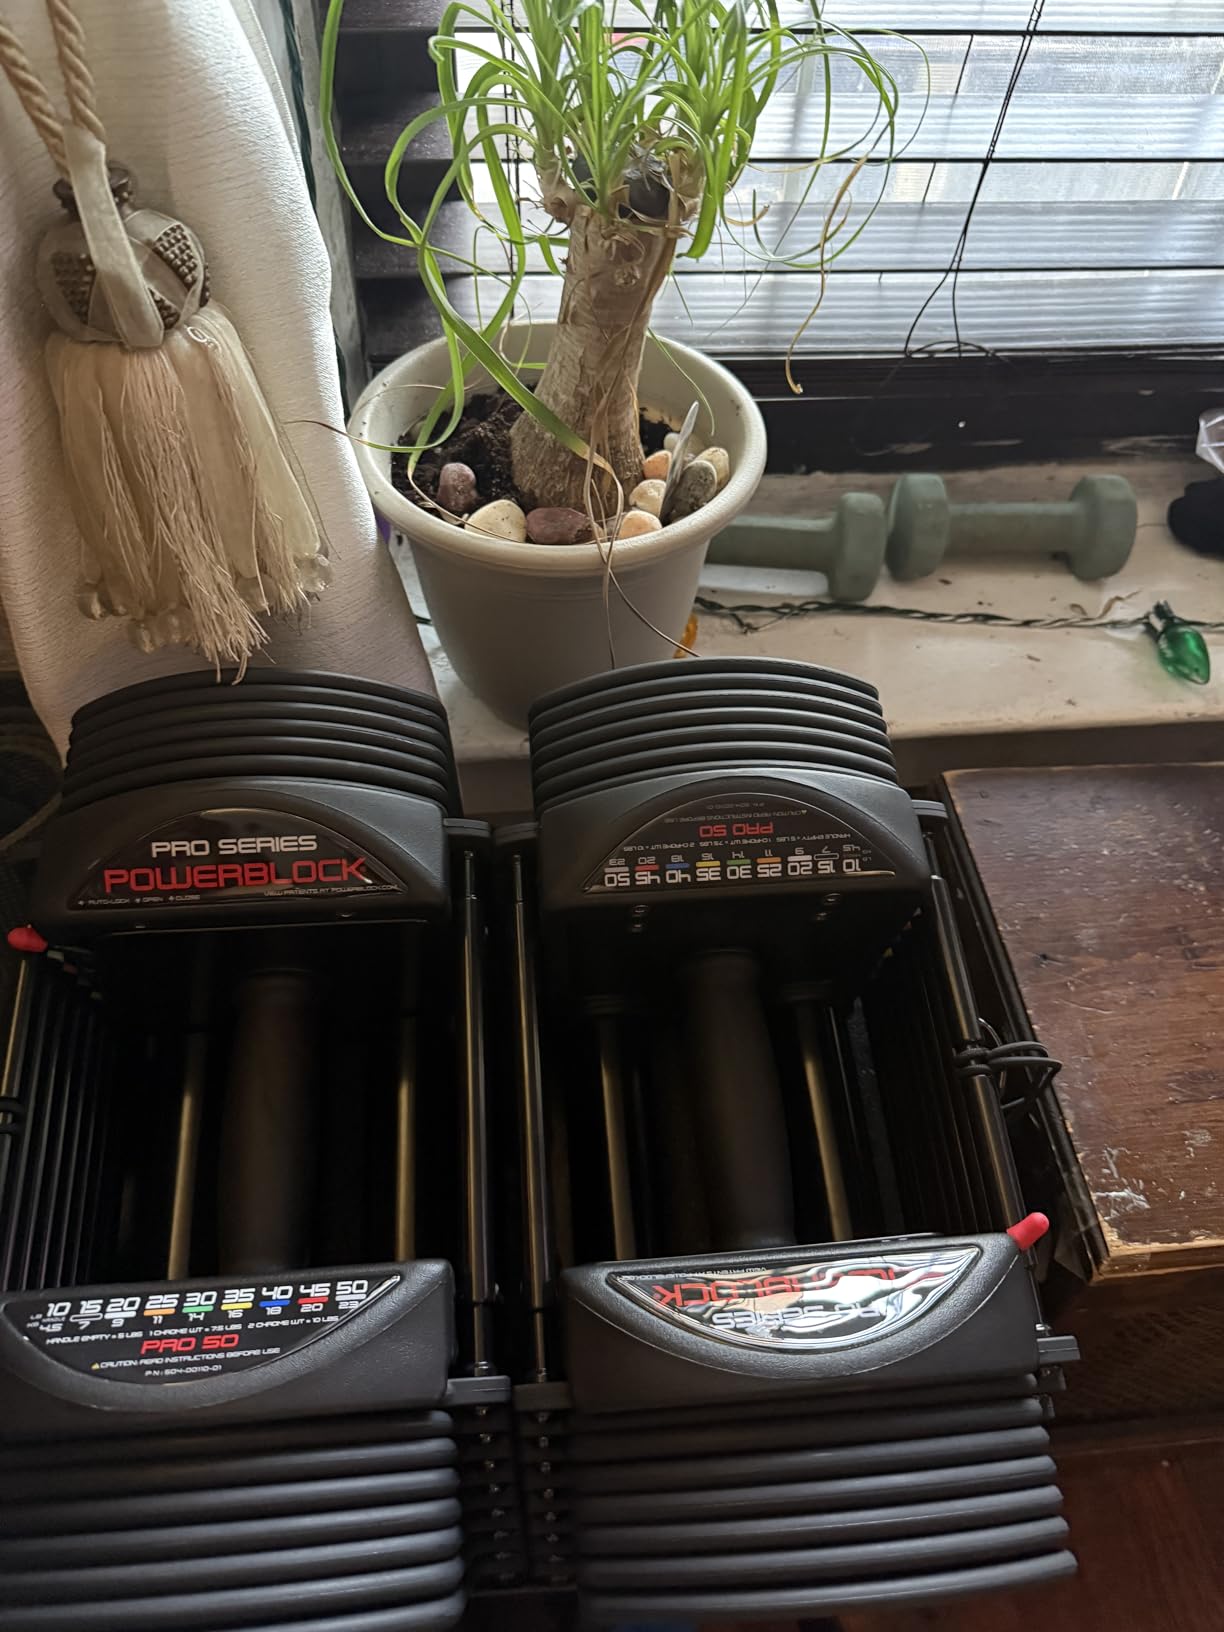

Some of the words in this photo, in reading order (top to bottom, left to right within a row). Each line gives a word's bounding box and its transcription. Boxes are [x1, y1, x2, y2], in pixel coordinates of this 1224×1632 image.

[699, 824, 727, 838] 50
[732, 822, 774, 836] PRO
[151, 839, 210, 858] PRO
[218, 835, 317, 854] SERIES
[764, 849, 773, 857] 11
[795, 847, 804, 855] 9
[822, 845, 832, 854] 7
[638, 856, 656, 865] 20
[671, 854, 684, 863] 18
[701, 852, 714, 861] 16
[732, 850, 745, 859] 14
[609, 858, 625, 866] 23
[787, 861, 813, 876] 20
[817, 860, 836, 874] 15
[842, 859, 861, 873] 10
[103, 857, 373, 893] POWERBLOCK
[666, 869, 692, 884] 40
[696, 867, 721, 882] 35
[727, 865, 753, 880] 30
[757, 863, 782, 878] 25
[604, 873, 630, 887] 50
[635, 871, 661, 885] 45
[47, 1302, 71, 1317] 10
[80, 1299, 104, 1314] 15
[106, 1297, 141, 1312] 20
[145, 1294, 180, 1309] 25
[183, 1291, 217, 1306] 30
[222, 1288, 256, 1303] 35
[261, 1285, 293, 1300] 40
[300, 1282, 331, 1297] 45
[335, 1280, 368, 1294] 50
[79, 1321, 91, 1330] 7
[110, 1318, 125, 1327] 9
[153, 1315, 163, 1324] 11
[188, 1312, 205, 1322] 14
[227, 1309, 243, 1319] 16
[266, 1306, 282, 1315] 18
[300, 1303, 323, 1312] 20
[338, 1300, 359, 1310] 23
[46, 1336, 80, 1345] HANDLE
[81, 1334, 111, 1342] EMPTY
[153, 1327, 188, 1336] CHROME
[189, 1326, 204, 1334] WT
[225, 1323, 242, 1331] LBS
[255, 1319, 289, 1328] CHROME
[290, 1318, 305, 1326] WT
[140, 1337, 196, 1355] PRO
[201, 1333, 239, 1350] 50
[139, 1357, 164, 1365] READ
[164, 1352, 225, 1364] INSTRUCTIONS
[226, 1349, 261, 1358] BEFORE
[262, 1347, 281, 1355] USE
